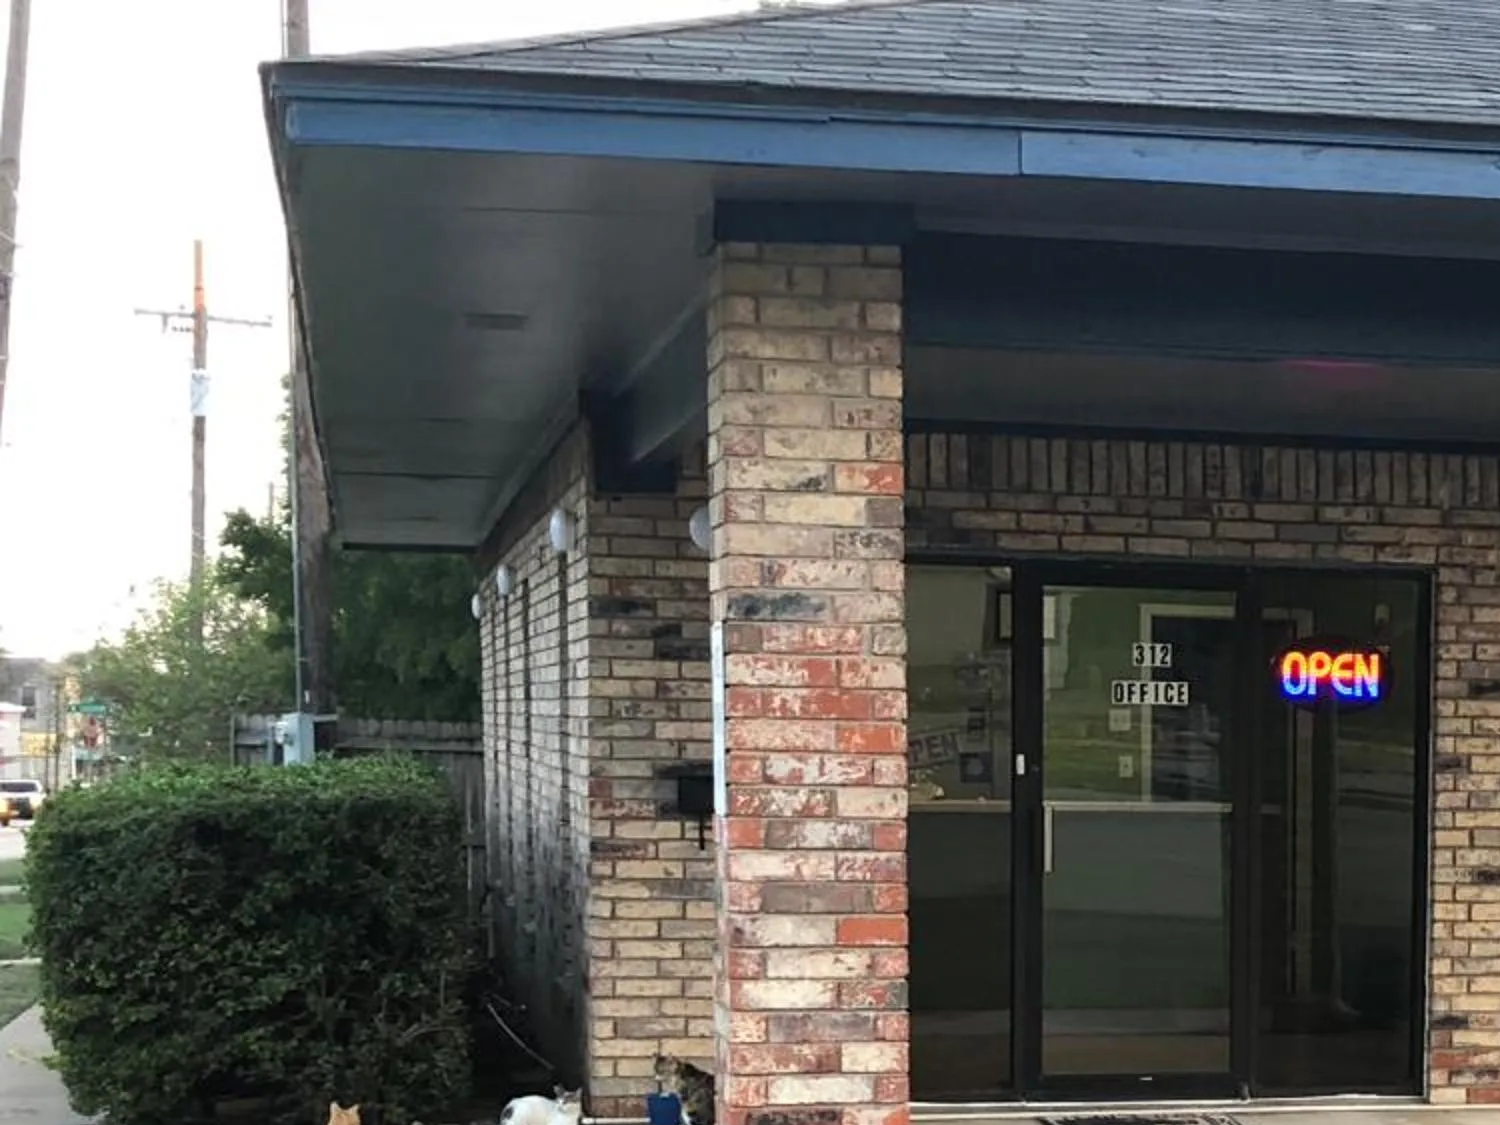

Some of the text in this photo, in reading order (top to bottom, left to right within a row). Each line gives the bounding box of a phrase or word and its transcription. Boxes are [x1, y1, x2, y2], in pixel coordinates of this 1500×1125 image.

[1134, 644, 1170, 666] 312
[1282, 650, 1380, 697] OPEN
[1113, 682, 1186, 704] OFFICE
[908, 733, 957, 764] PEN
